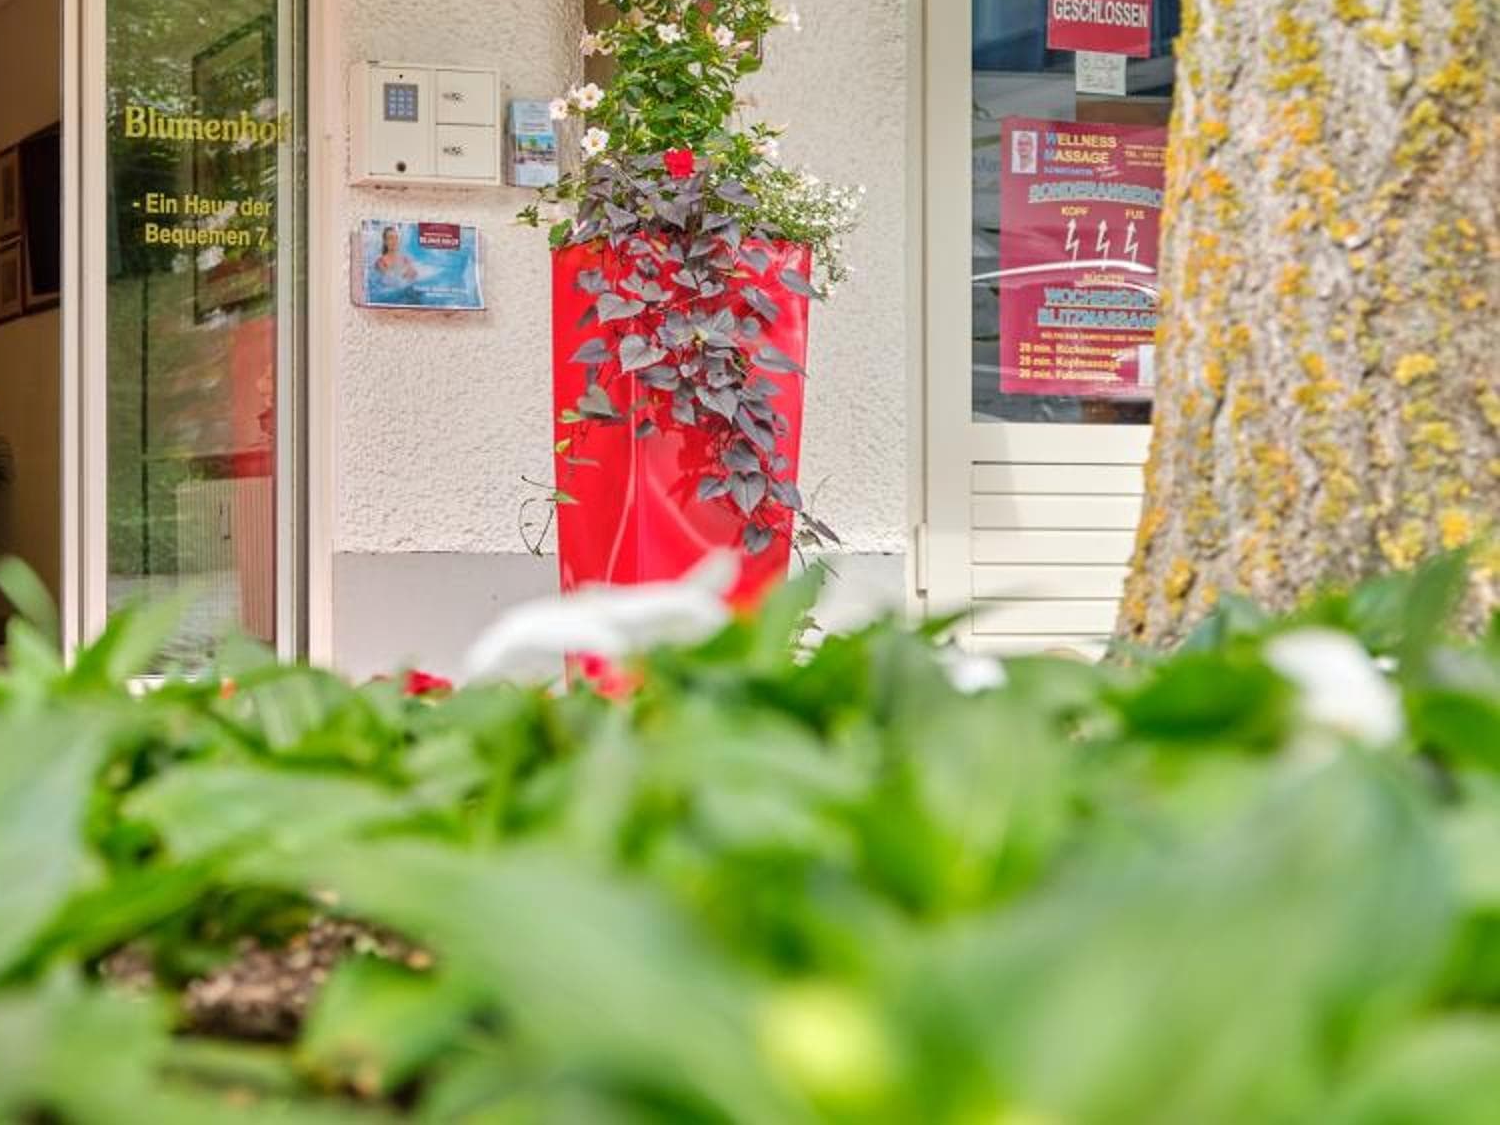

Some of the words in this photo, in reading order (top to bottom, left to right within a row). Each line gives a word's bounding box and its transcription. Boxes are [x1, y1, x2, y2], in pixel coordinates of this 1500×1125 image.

[124, 105, 292, 144] Blumenhof
[1045, 131, 1118, 149] WELLNESS
[1044, 149, 1110, 165] MASSAGE
[146, 193, 178, 214] Ein
[241, 197, 272, 216] der
[145, 223, 251, 248] Bequemen
